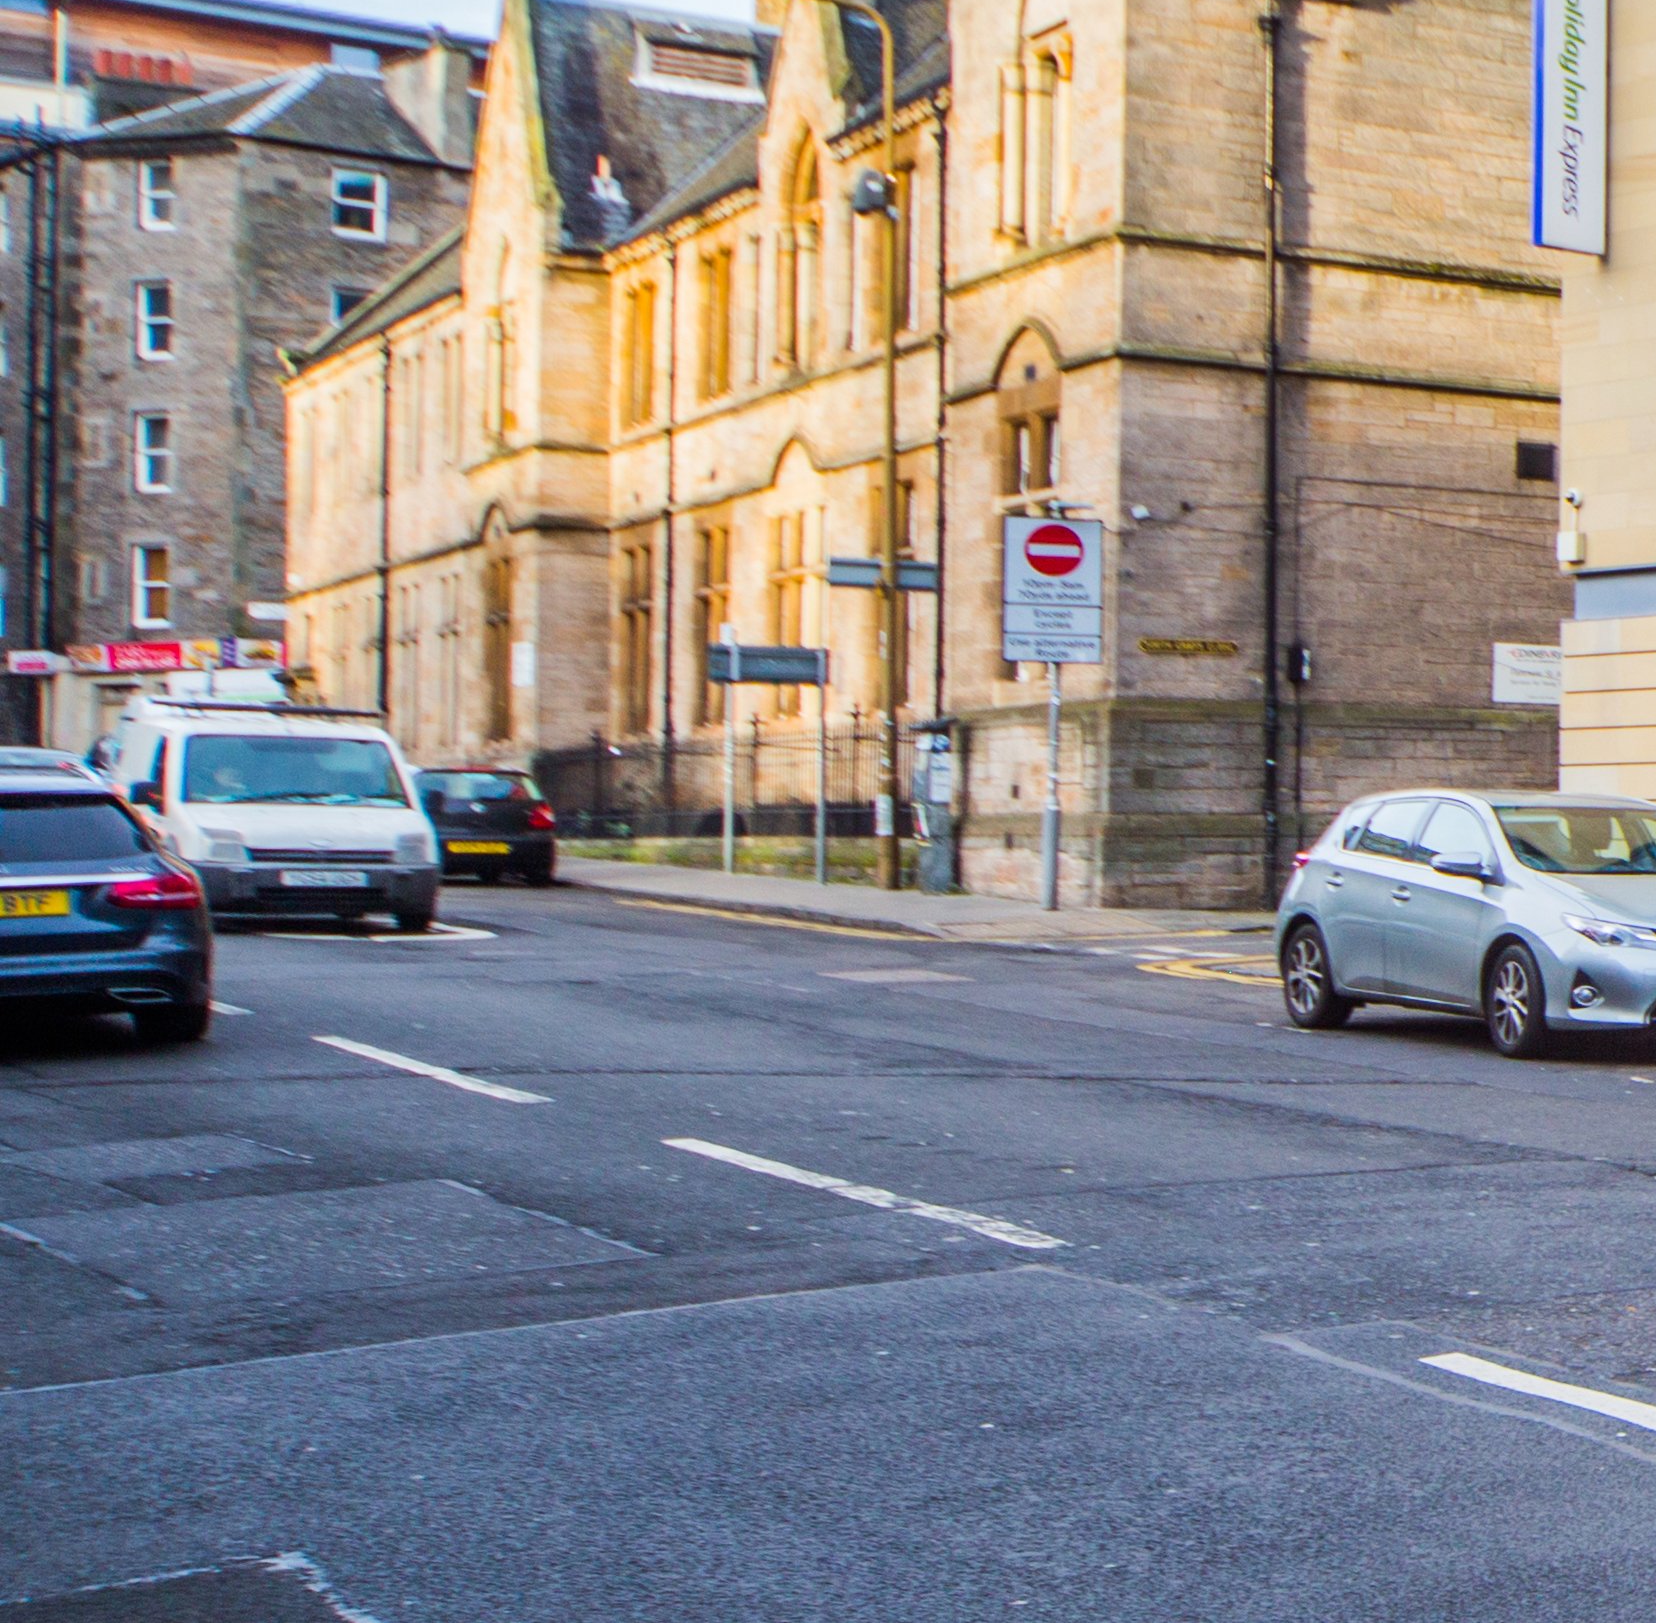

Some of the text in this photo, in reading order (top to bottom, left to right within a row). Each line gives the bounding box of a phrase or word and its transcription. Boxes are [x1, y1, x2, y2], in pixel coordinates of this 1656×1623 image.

[1563, 78, 1588, 122] Inn
[1559, 123, 1584, 218] Express
[1033, 638, 1096, 649] alternative
